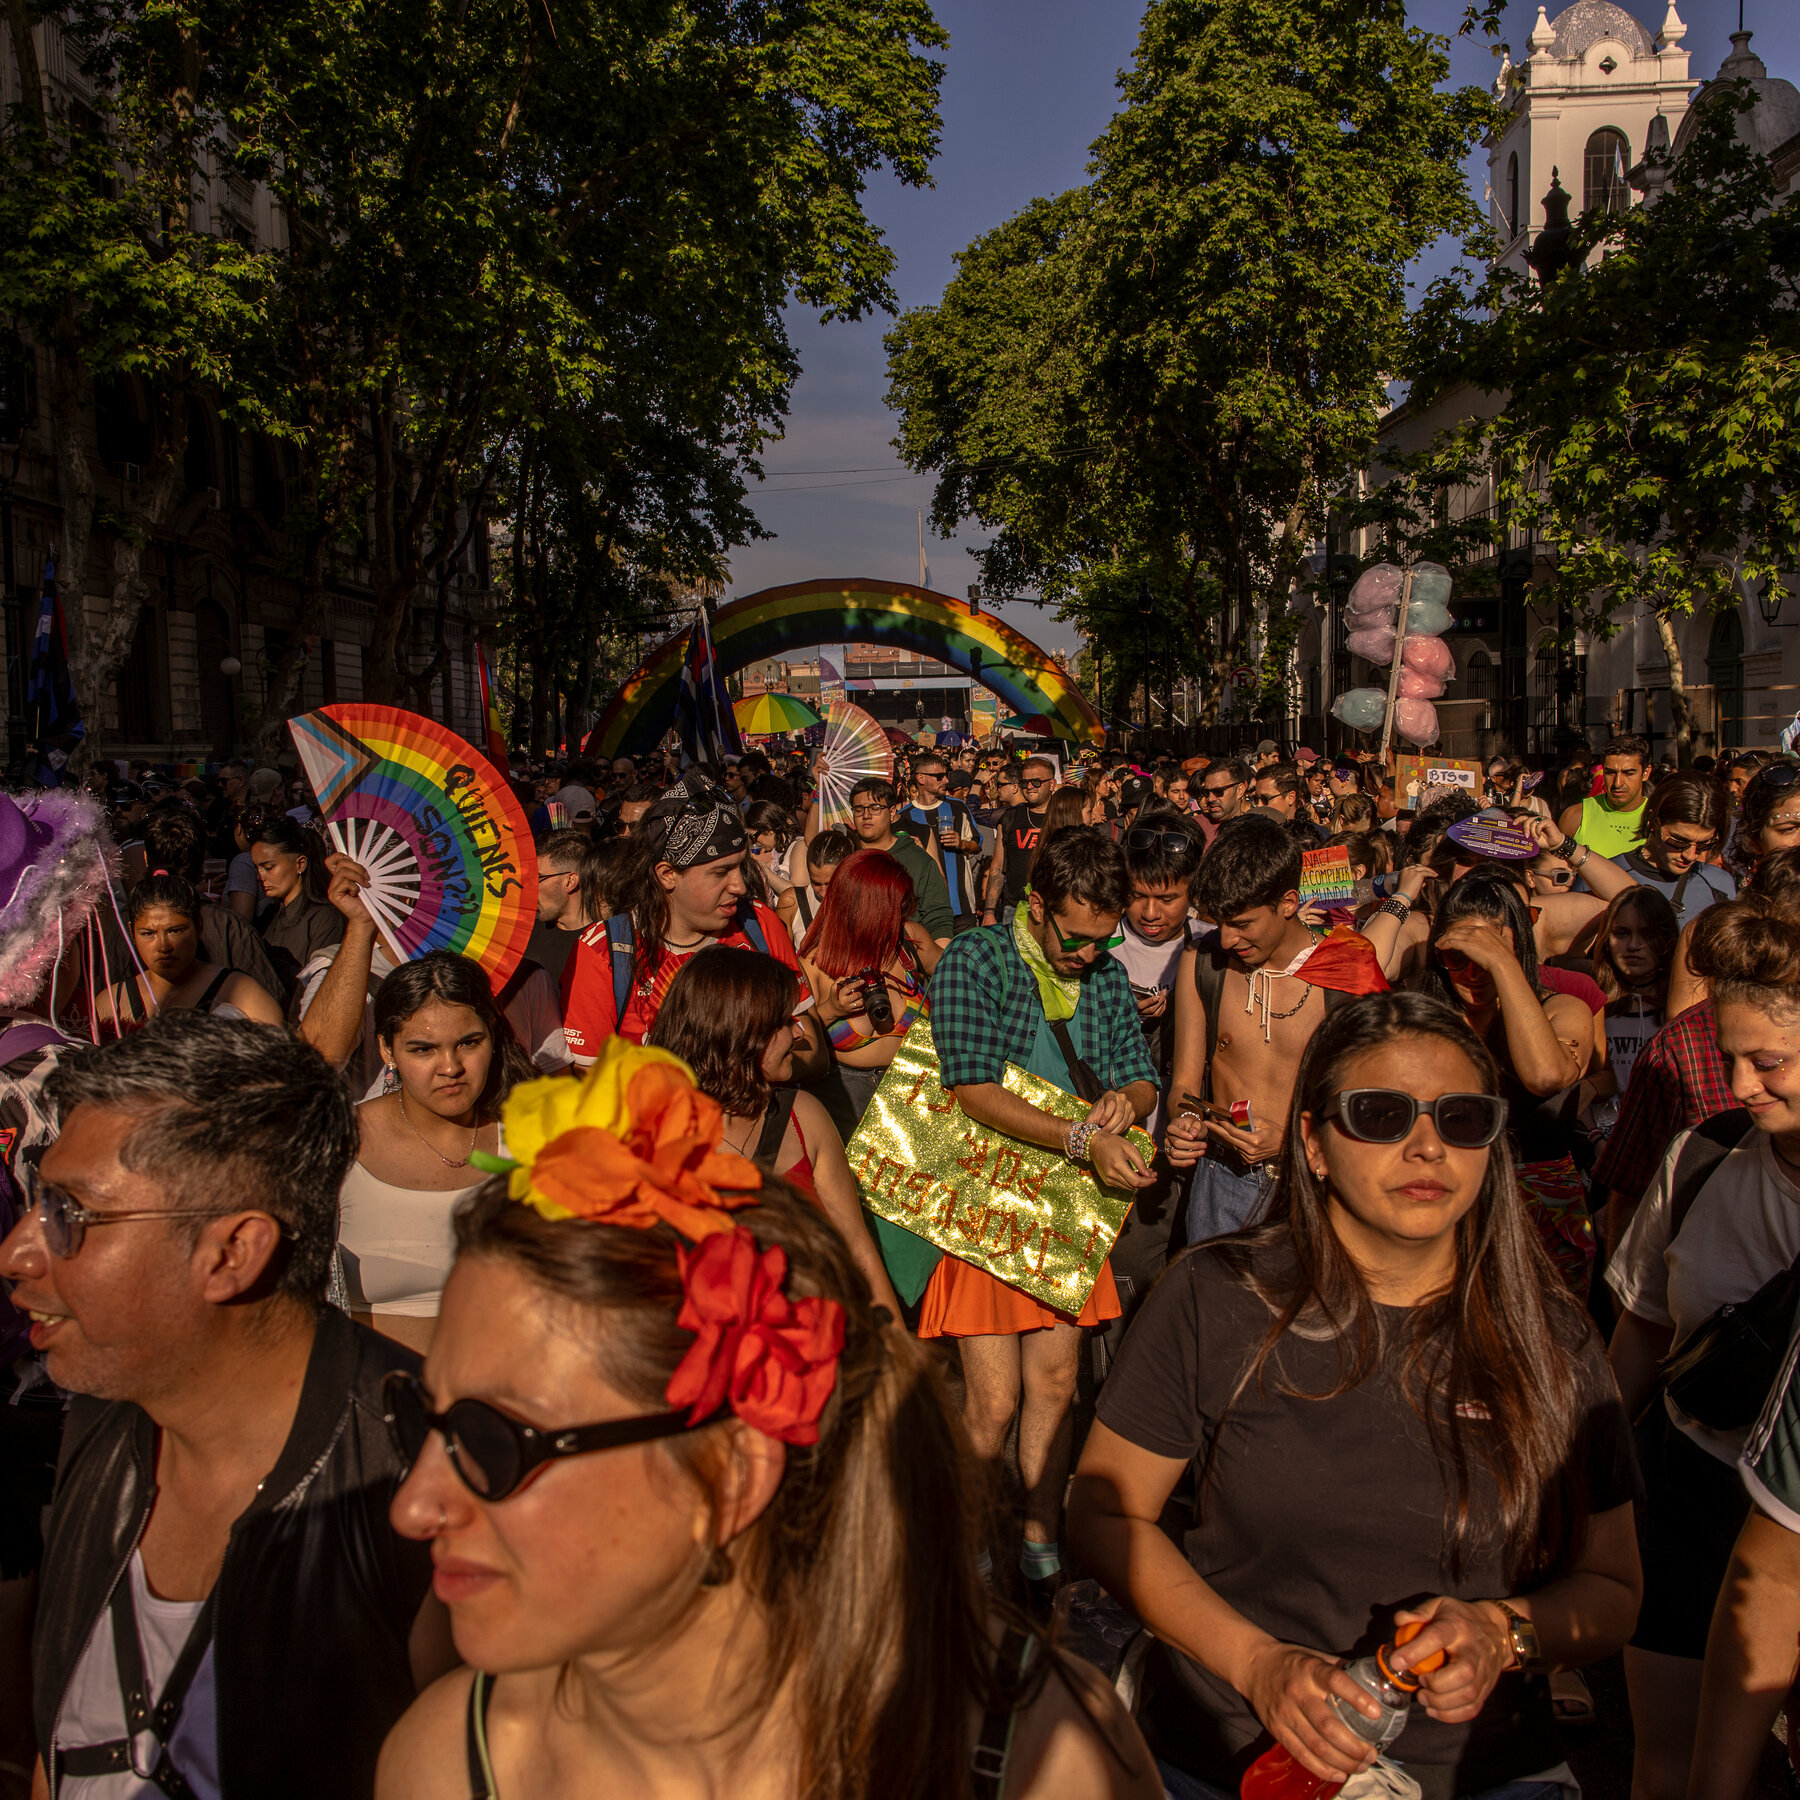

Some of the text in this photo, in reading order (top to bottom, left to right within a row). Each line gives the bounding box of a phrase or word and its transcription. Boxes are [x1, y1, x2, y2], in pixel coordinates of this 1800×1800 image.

[1429, 769, 1457, 782] BTS
[444, 764, 524, 898] QUIÉNES
[1311, 886, 1349, 906] MUNDO
[957, 1132, 1049, 1203] POR
